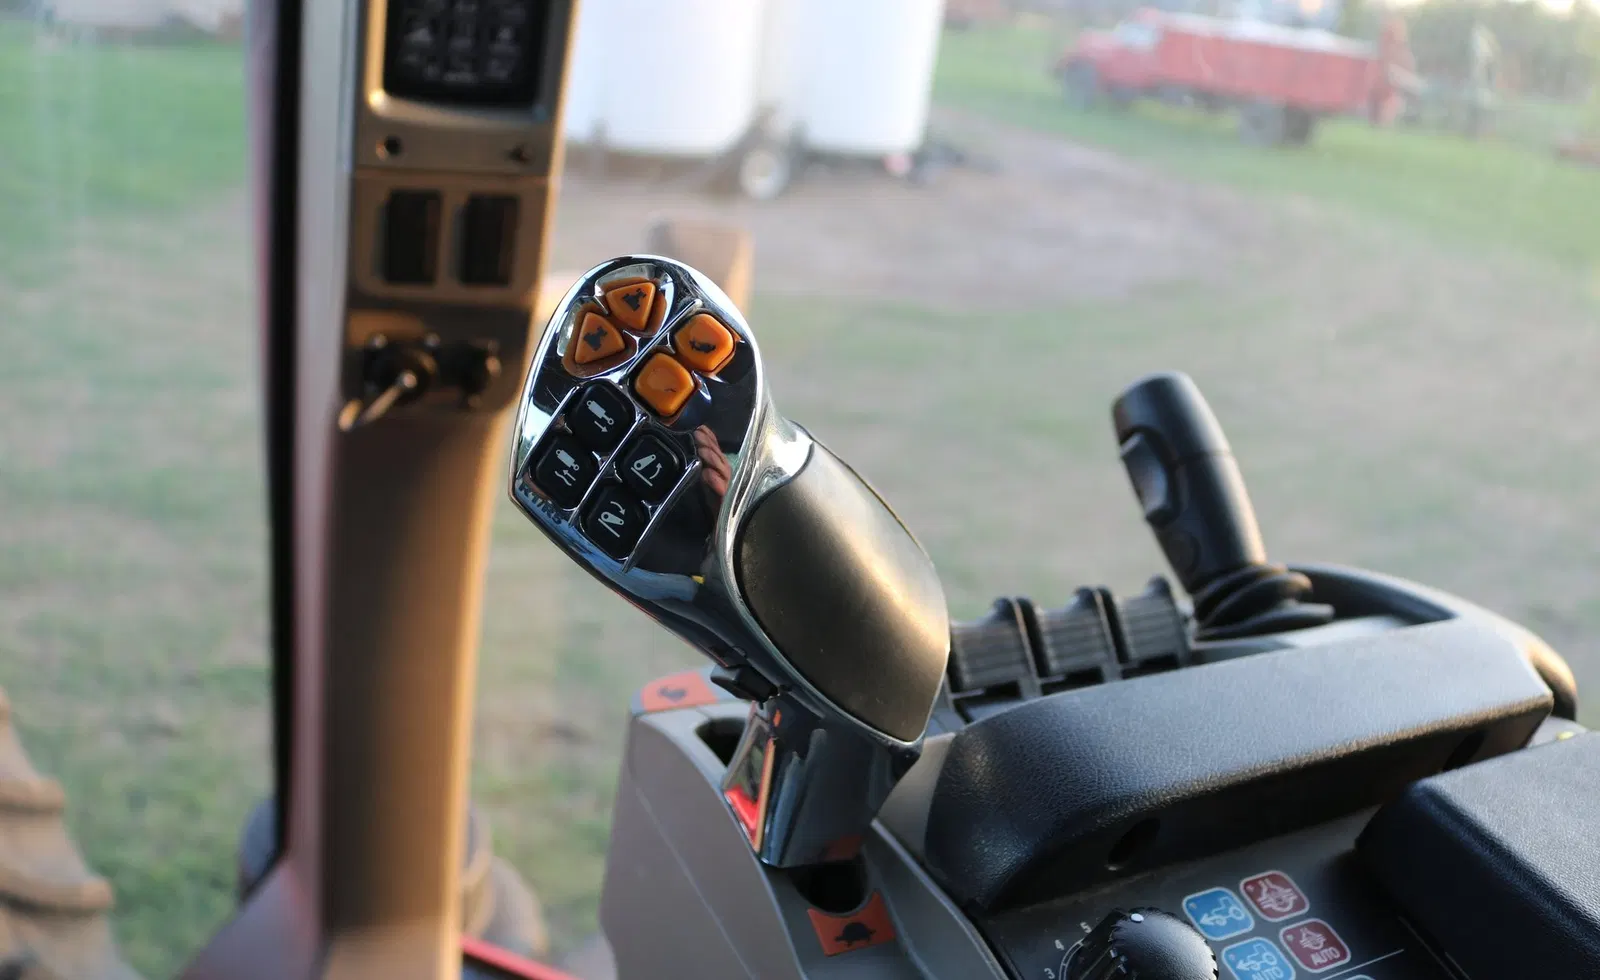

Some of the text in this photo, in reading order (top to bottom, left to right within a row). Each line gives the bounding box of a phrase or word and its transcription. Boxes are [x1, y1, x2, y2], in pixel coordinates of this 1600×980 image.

[1080, 921, 1092, 933] 5
[1054, 939, 1065, 950] 4
[1310, 947, 1340, 965] AUTO
[1044, 967, 1055, 979] 3
